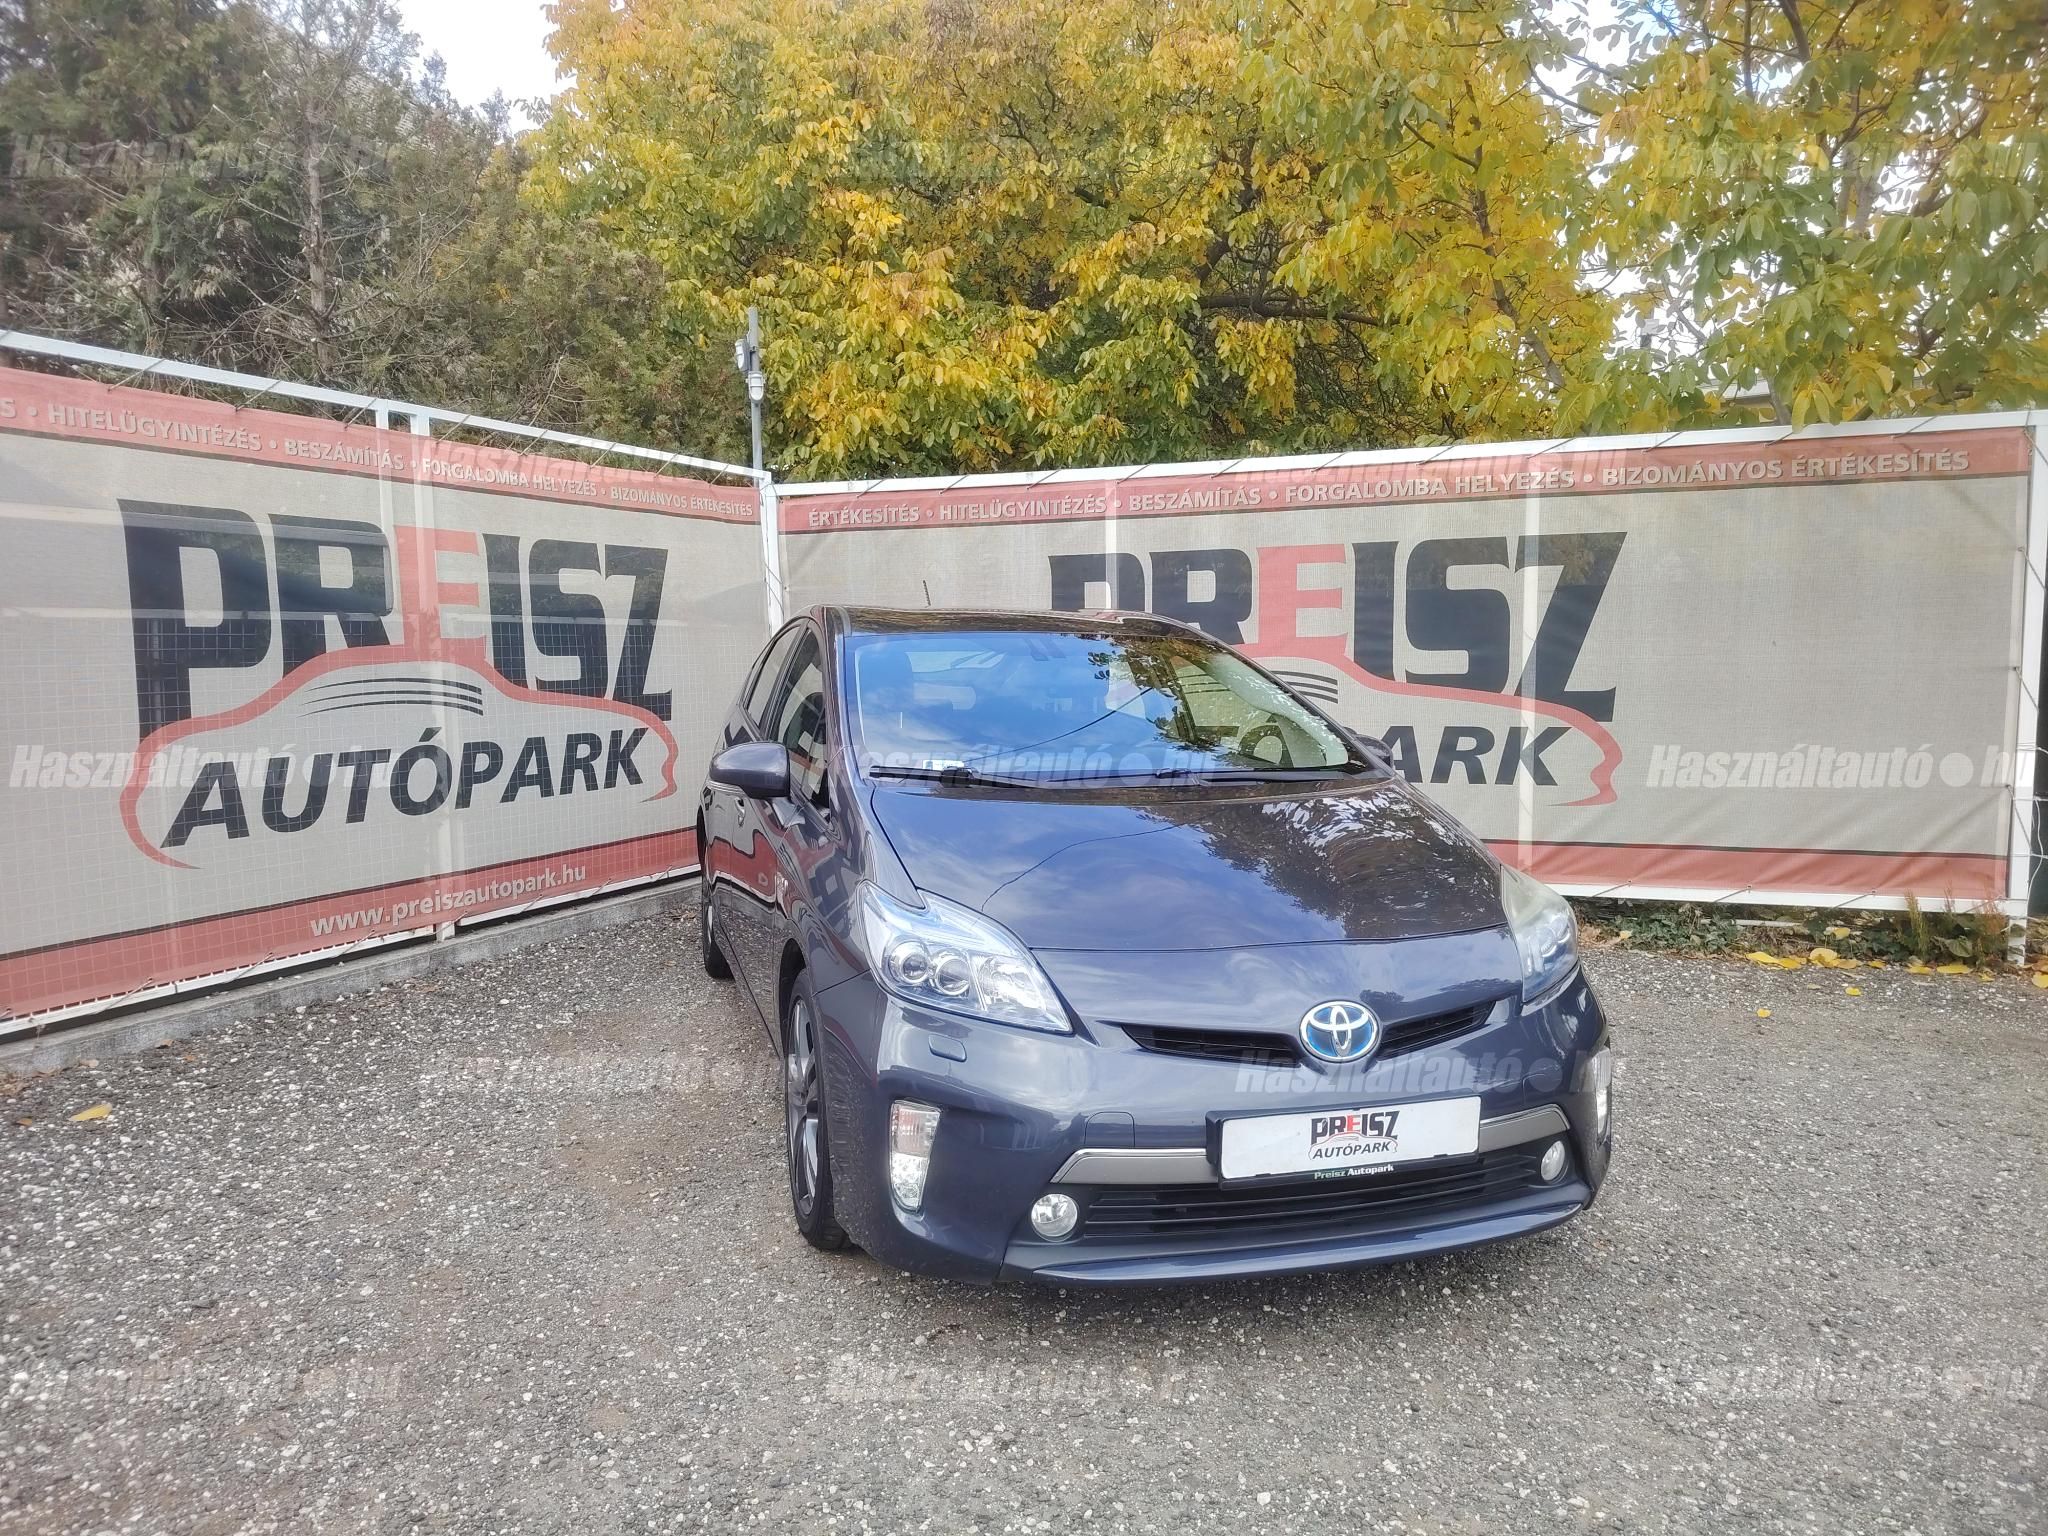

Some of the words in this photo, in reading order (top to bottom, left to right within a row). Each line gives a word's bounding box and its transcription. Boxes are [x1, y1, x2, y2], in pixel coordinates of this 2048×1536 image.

[49, 402, 261, 452] HITELÜGYINTÉZÉS
[285, 438, 404, 470] BESZÁMÍTÁS
[422, 457, 528, 488] FORGALOMBA
[532, 476, 597, 496] HELYEZÉS
[611, 486, 688, 510] BIZOMÁNYOS
[690, 494, 753, 516] ÉRTÉKESÍTÉS
[808, 503, 919, 528] ÉRTÉKESÍTÉS
[939, 495, 1106, 521] HITELÜGYINTÉZÉS
[1128, 487, 1261, 512] BESZÁMÍTÁS
[1285, 477, 1448, 503] FORGALOMBA
[1455, 466, 1575, 494] HELYEZÉS
[1602, 457, 1783, 486] BIZOMÁNYOS
[1791, 450, 1969, 478] ÉRTÉKESÍTÉS
[118, 499, 672, 741] PREISZ
[160, 727, 649, 848] AUTÓPARK
[310, 864, 587, 937] www.preiszautopark.hu
[1311, 1110, 1400, 1146] PREISZ
[1312, 1140, 1391, 1160] AUTÓPARK
[1314, 1170, 1346, 1180] Preisz
[1347, 1164, 1394, 1177] Autopark
